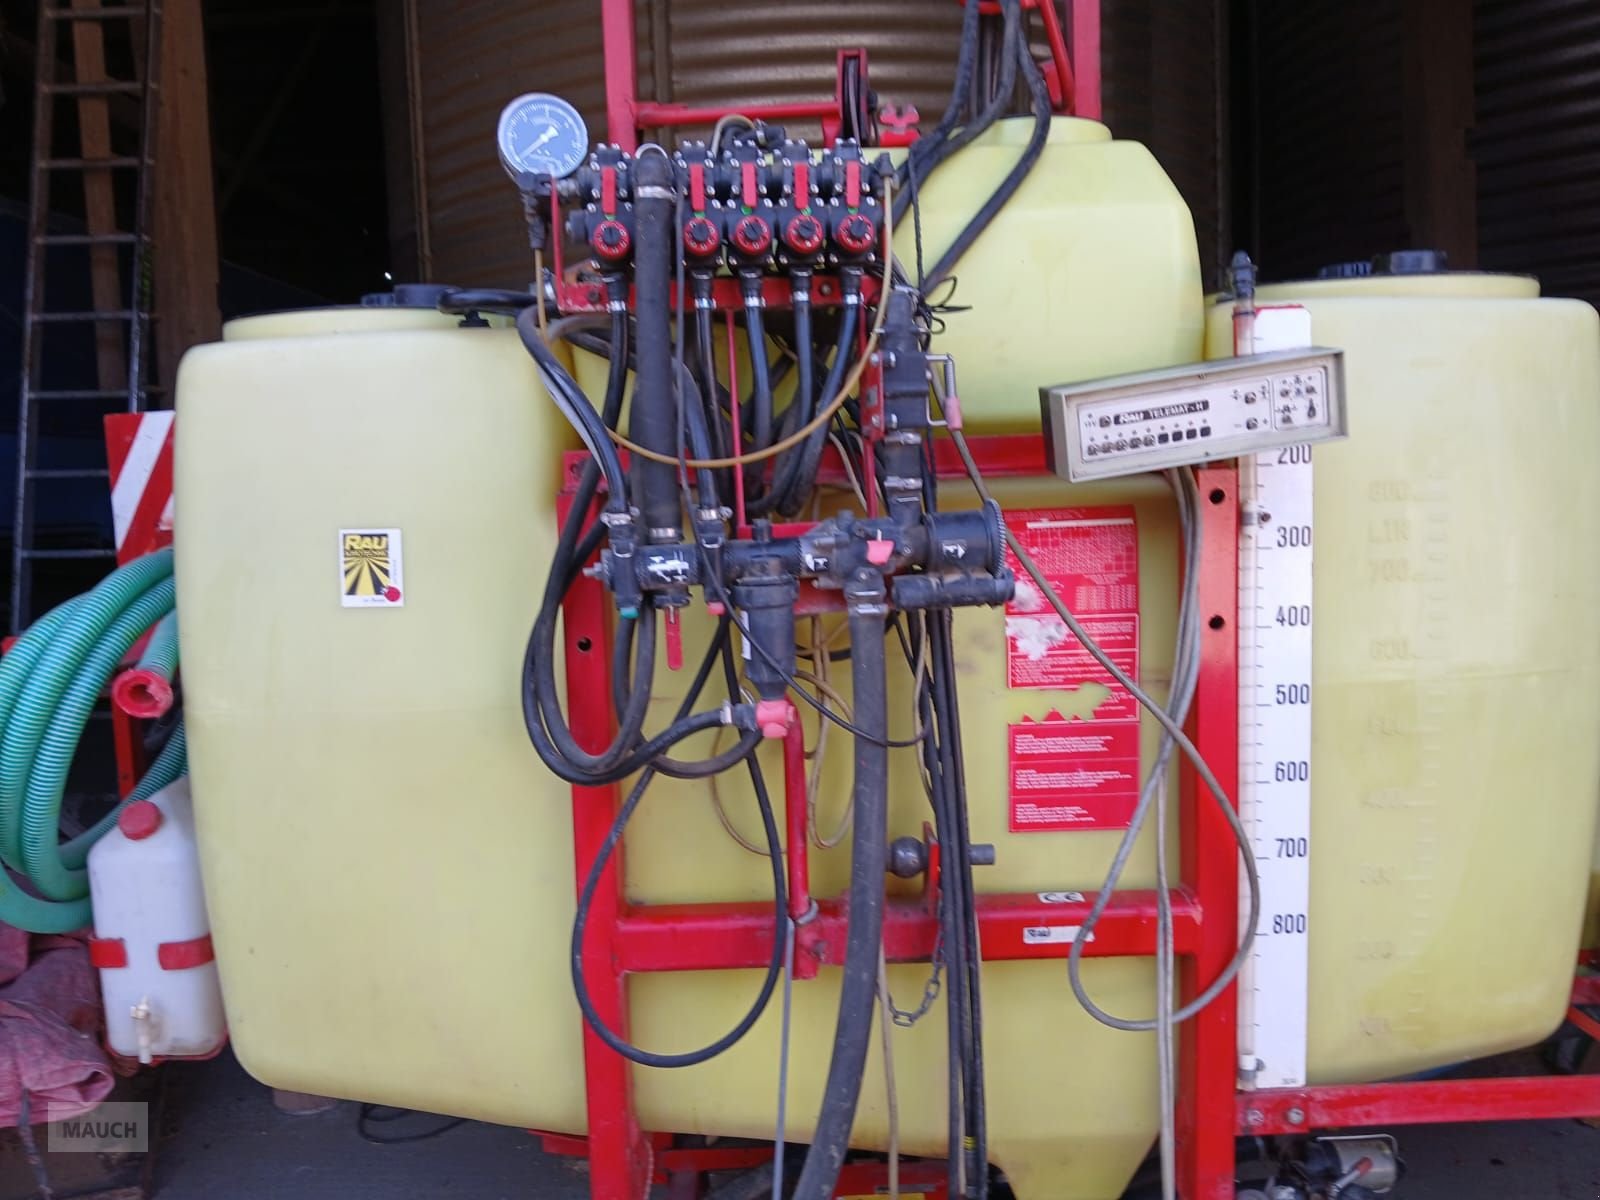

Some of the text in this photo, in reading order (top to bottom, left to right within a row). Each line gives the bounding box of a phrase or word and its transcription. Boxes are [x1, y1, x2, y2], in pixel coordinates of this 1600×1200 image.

[1277, 443, 1312, 464] 200
[345, 534, 387, 550] RAU
[1276, 526, 1311, 548] 300
[1276, 605, 1310, 627] 400
[1276, 683, 1310, 705] 500
[1275, 761, 1309, 783] 600
[1274, 837, 1307, 858] 700
[1272, 914, 1307, 935] 800
